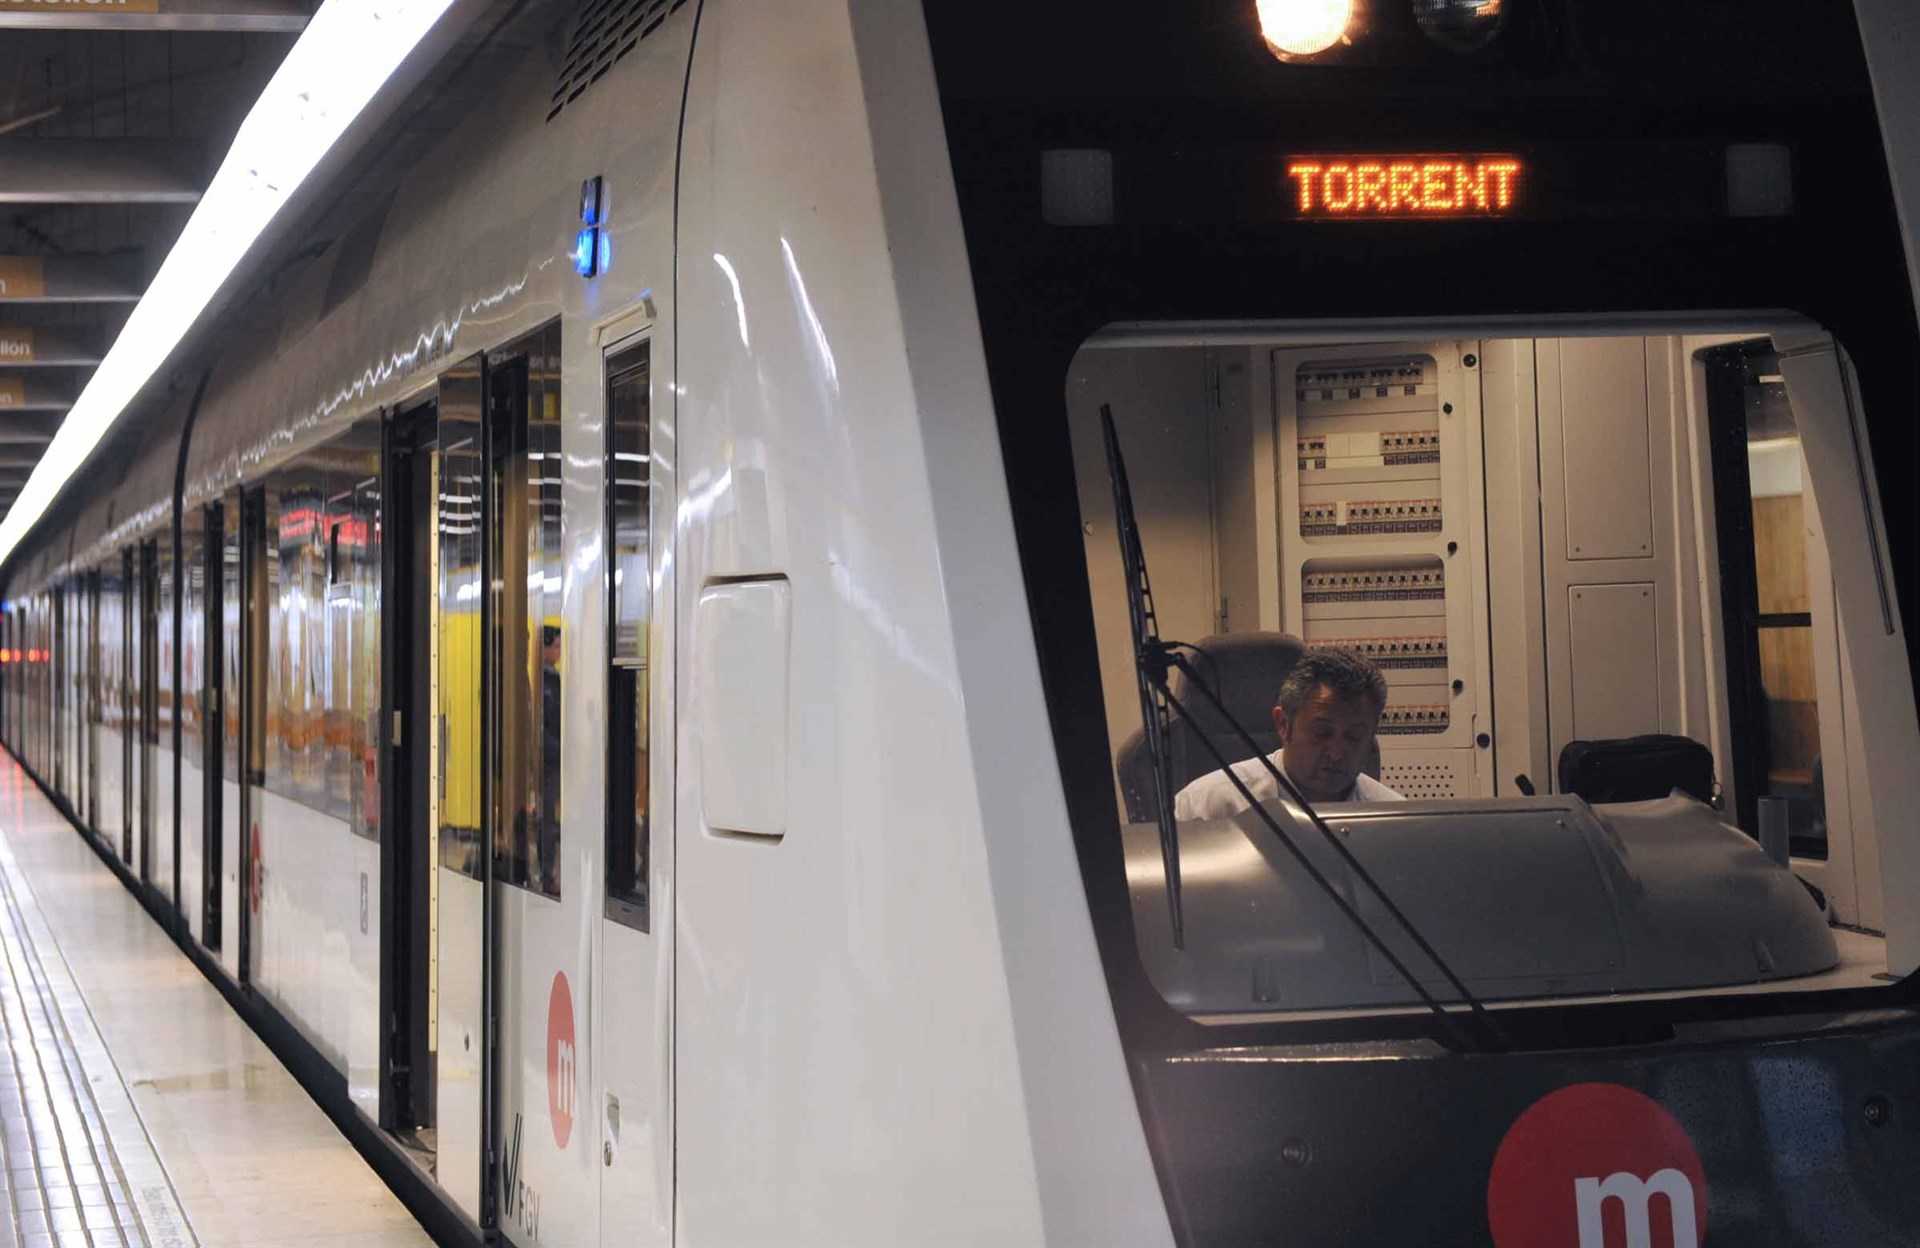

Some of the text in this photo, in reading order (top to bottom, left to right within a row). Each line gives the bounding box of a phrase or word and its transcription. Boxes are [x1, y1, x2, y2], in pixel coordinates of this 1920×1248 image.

[1289, 162, 1520, 209] TORRENT
[519, 1179, 541, 1241] FGV
[1574, 1168, 1698, 1248] m
